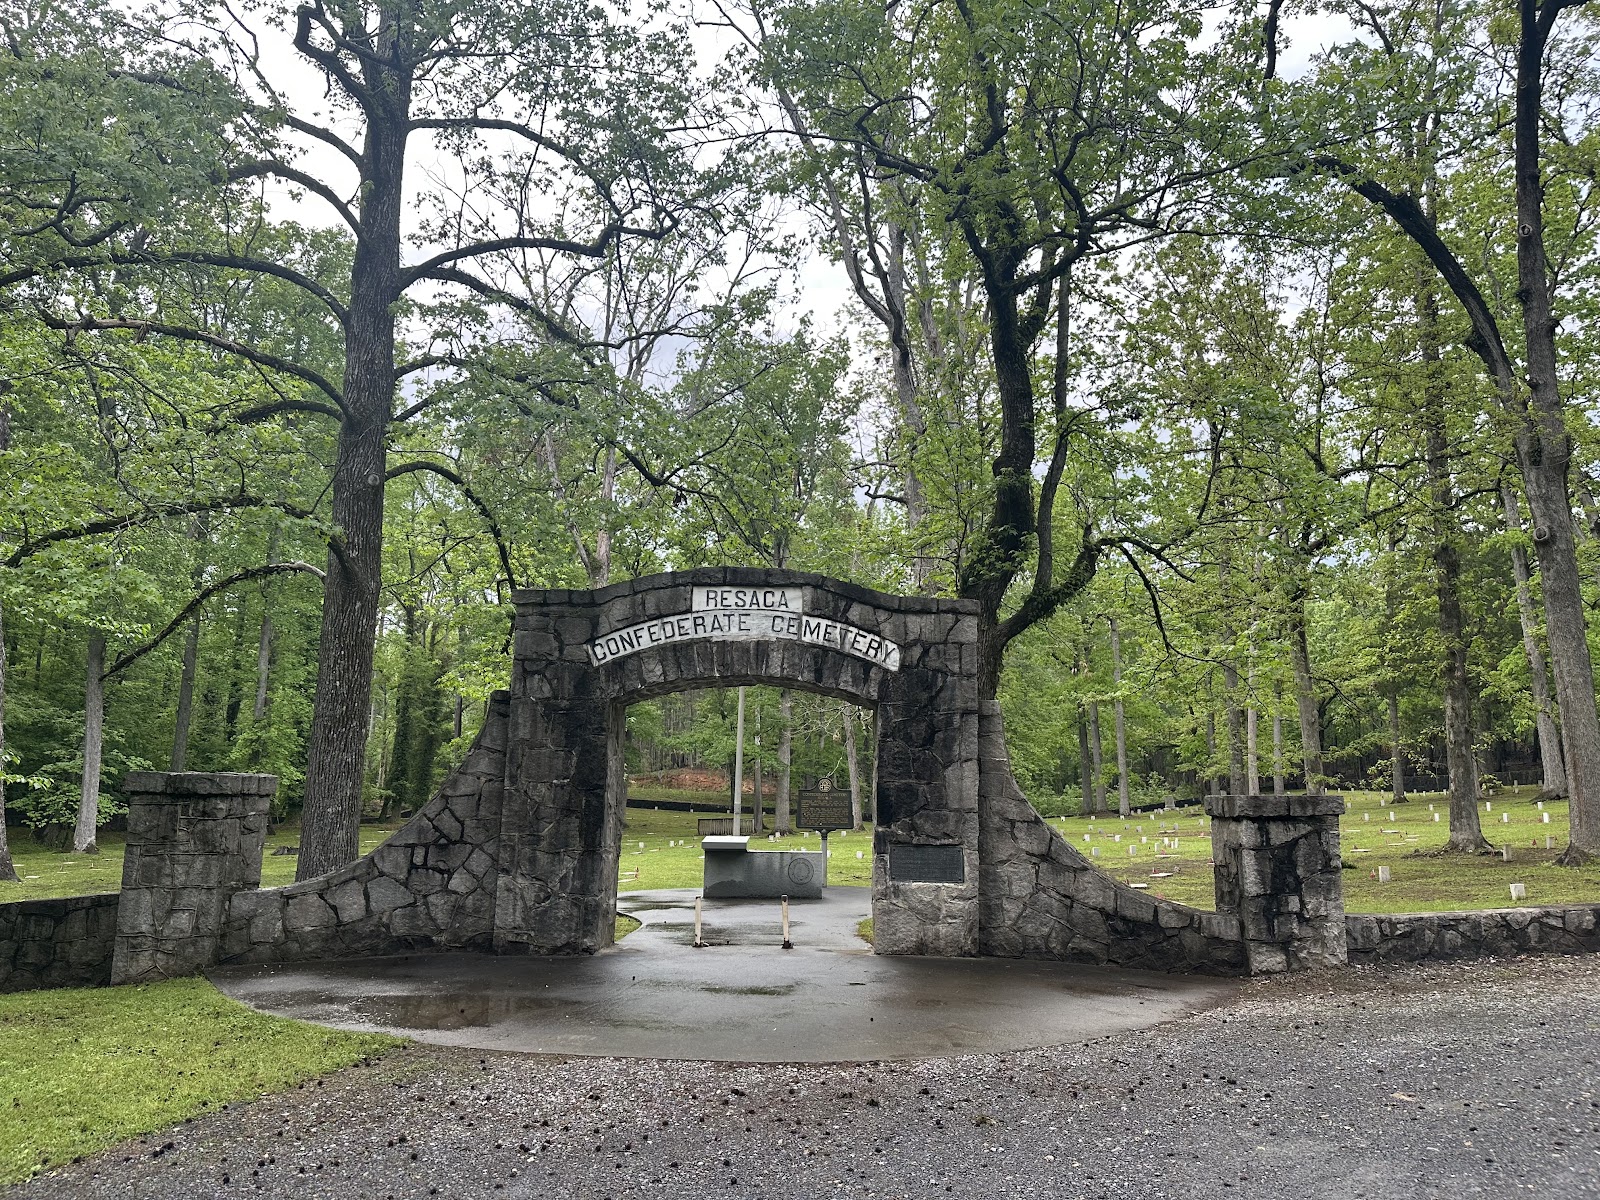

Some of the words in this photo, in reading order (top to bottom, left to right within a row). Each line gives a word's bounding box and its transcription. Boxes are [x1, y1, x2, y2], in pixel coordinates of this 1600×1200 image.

[706, 590, 789, 609] RESACA
[592, 613, 751, 661] CONFEDERATE
[771, 615, 897, 664] CEMETERY
